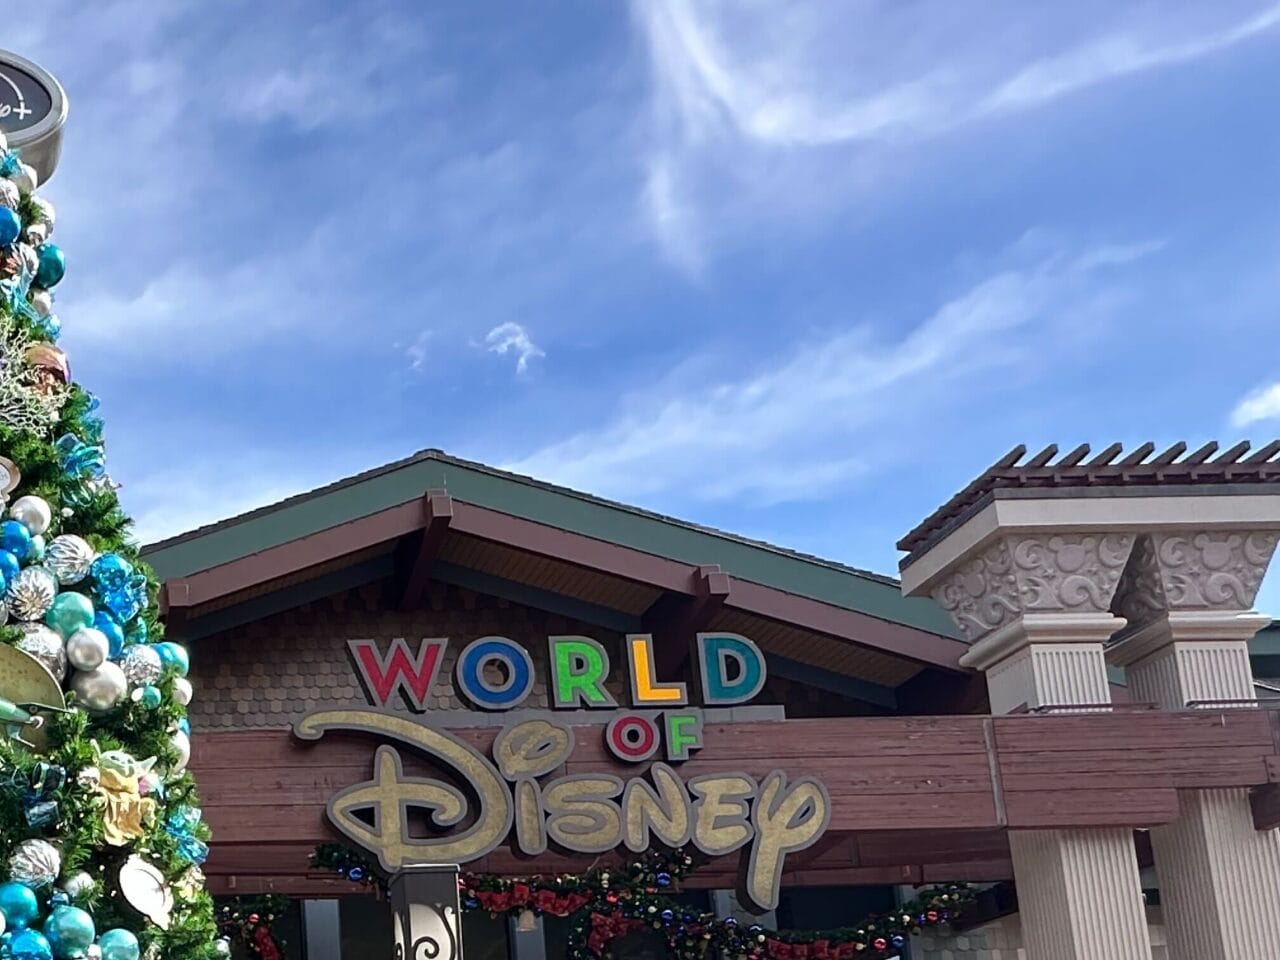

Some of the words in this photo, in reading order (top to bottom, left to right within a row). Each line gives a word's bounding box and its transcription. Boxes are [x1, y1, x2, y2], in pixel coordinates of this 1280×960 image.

[346, 633, 767, 711] WORLD
[606, 710, 704, 762] OF
[293, 708, 831, 912] Disney
